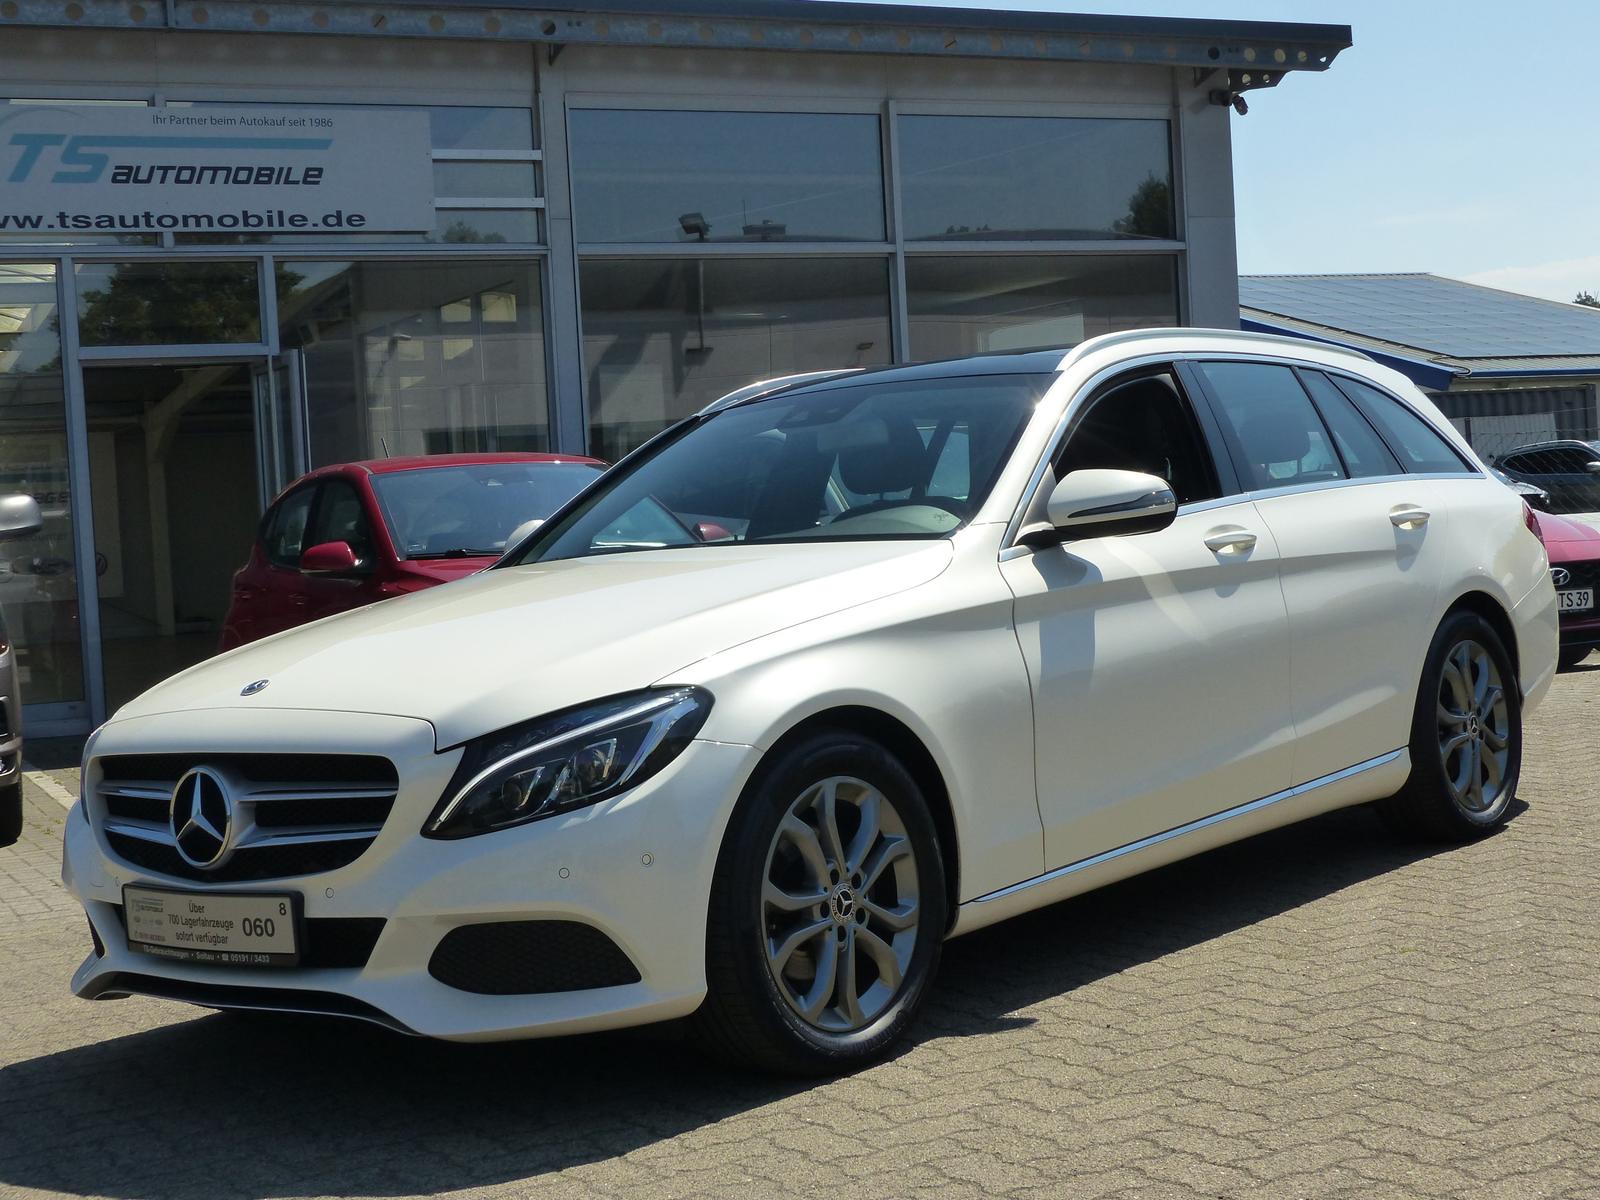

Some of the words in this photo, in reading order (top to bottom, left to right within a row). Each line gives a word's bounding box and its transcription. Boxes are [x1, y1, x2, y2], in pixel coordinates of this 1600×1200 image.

[152, 115, 167, 125] Ihr
[169, 115, 207, 126] Partner
[210, 115, 236, 126] beim
[239, 116, 286, 127] Autokauf
[288, 117, 306, 127] seit
[309, 118, 333, 128] 1986
[8, 133, 110, 183] TS
[1558, 592, 1574, 608] TS
[1576, 591, 1589, 607] 39
[188, 899, 205, 914] Über
[278, 902, 287, 916] 8
[168, 914, 181, 926] 700
[181, 915, 234, 929] Lagerfahrzeuge
[242, 917, 275, 938] 060
[175, 930, 195, 943] sofort
[195, 932, 229, 946] verfügbar
